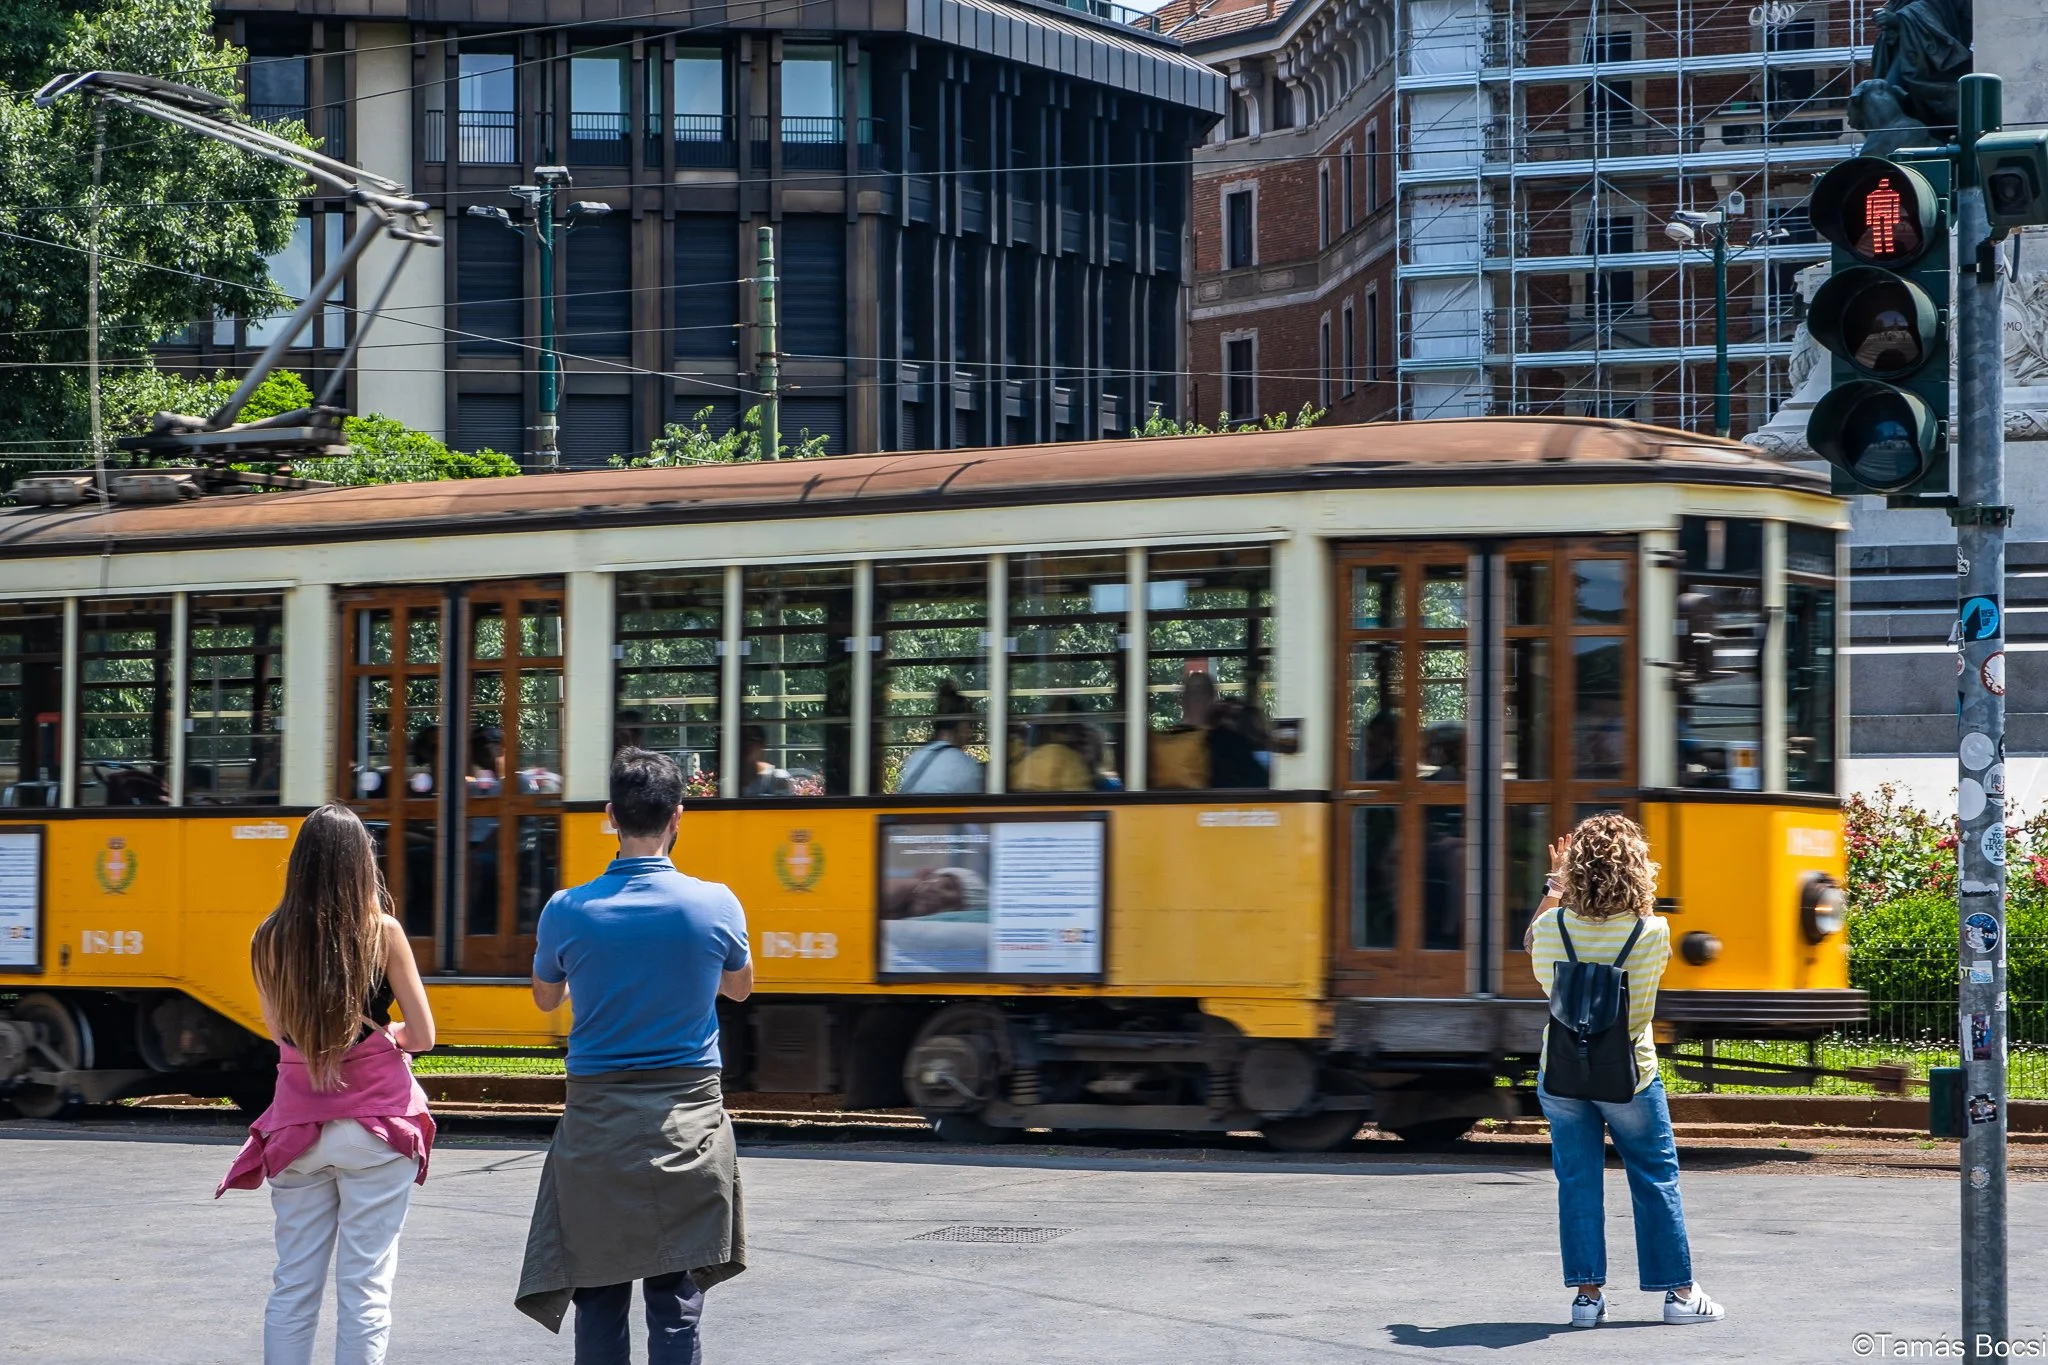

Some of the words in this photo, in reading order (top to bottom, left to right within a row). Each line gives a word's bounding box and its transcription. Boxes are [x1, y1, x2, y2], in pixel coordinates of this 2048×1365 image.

[2003, 321, 2022, 331] MO
[81, 930, 144, 954] 1843
[762, 931, 838, 958] 1843
